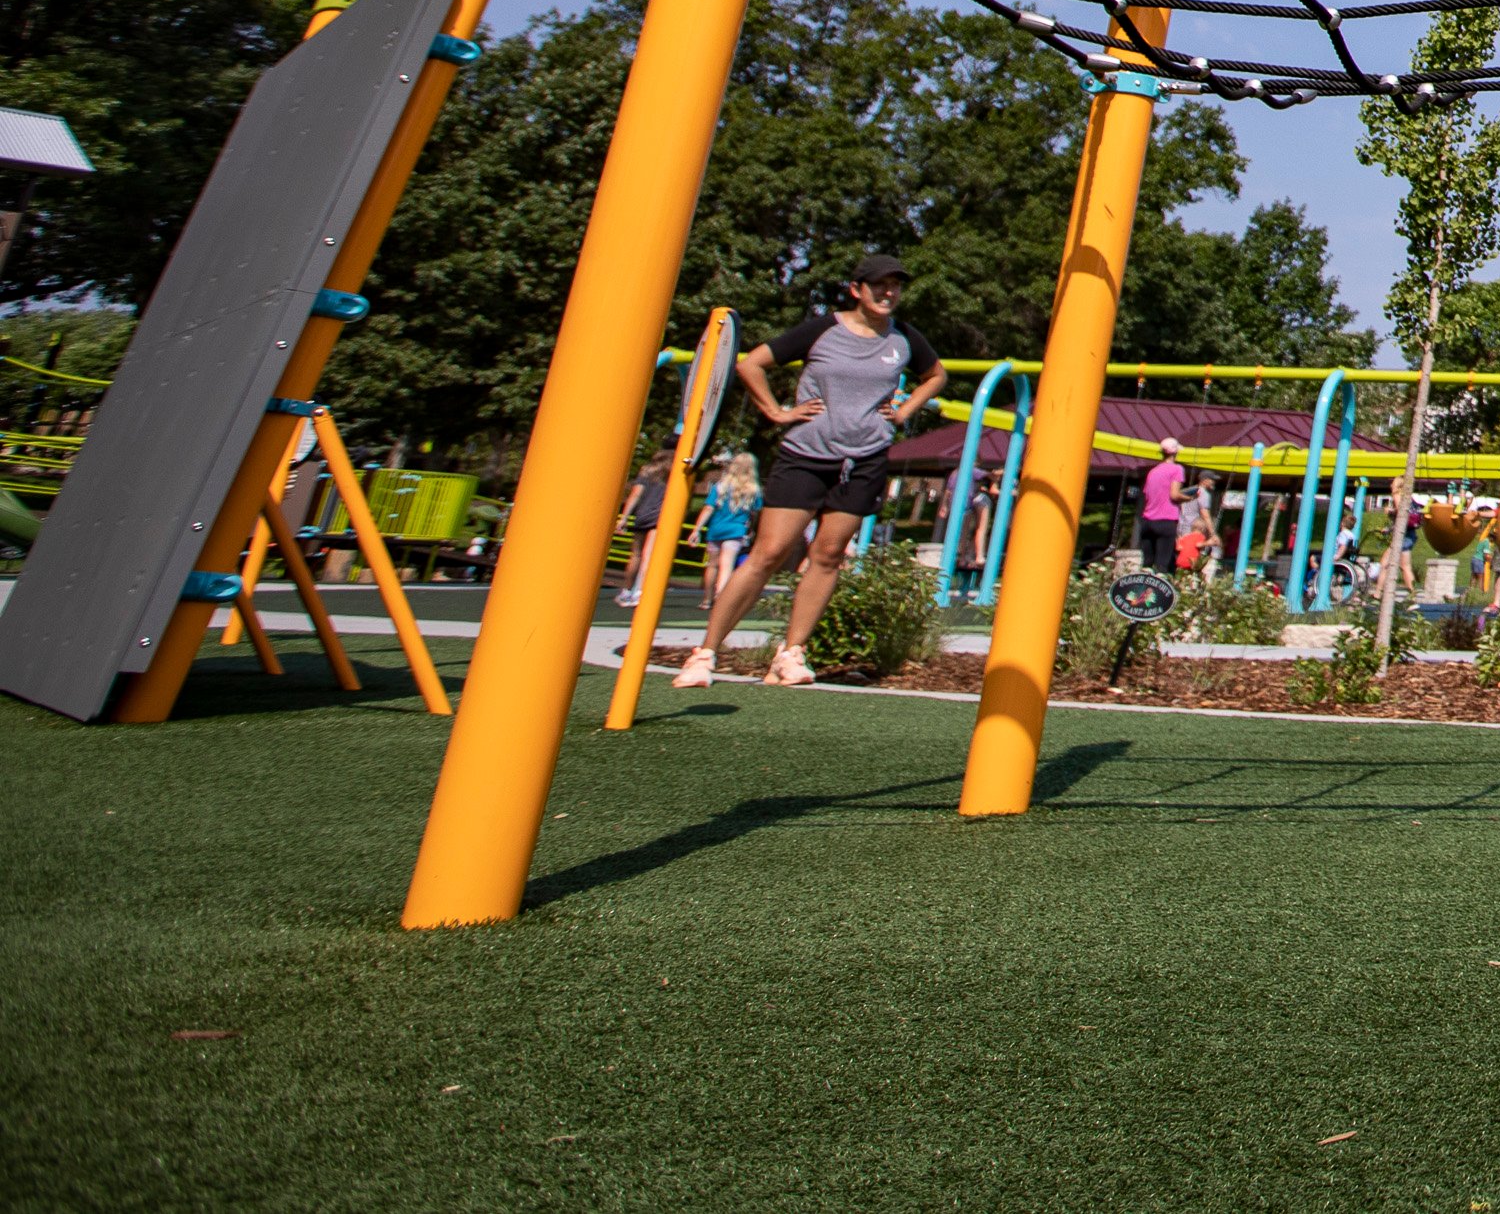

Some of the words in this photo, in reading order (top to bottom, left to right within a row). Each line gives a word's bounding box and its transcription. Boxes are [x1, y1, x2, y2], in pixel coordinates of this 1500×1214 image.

[1119, 576, 1145, 587] PLEASE
[1144, 576, 1160, 587] STAY
[1121, 602, 1144, 616] PLANT
[1143, 606, 1163, 616] AREA
